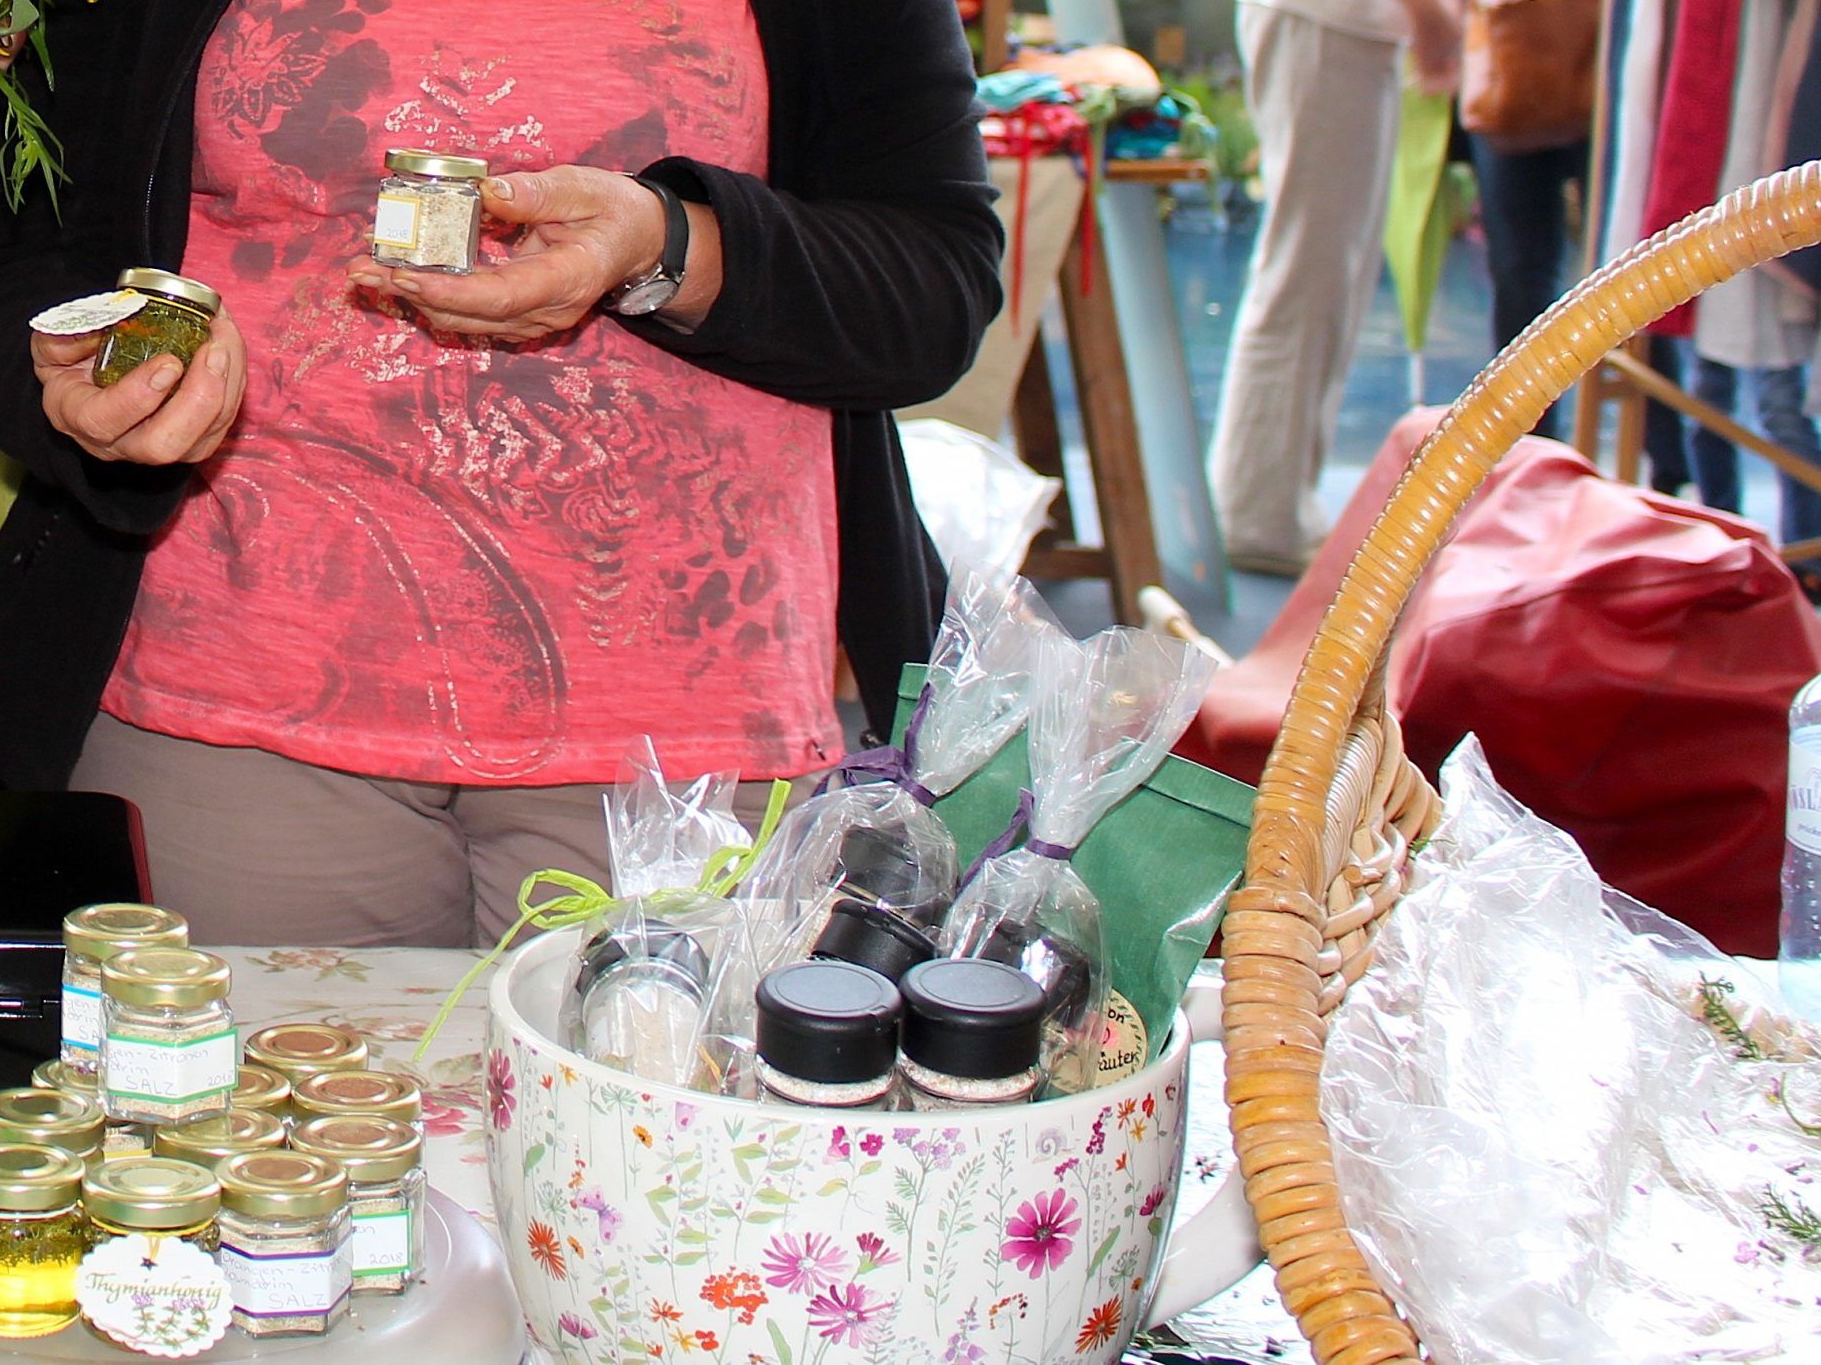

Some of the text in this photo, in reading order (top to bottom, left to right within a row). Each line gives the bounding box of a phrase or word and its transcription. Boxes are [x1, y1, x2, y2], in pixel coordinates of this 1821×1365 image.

[148, 1047, 209, 1064] Zitronen
[124, 1074, 178, 1096] SALZ
[369, 1251, 404, 1266] 2018
[268, 1293, 328, 1310] SALZ
